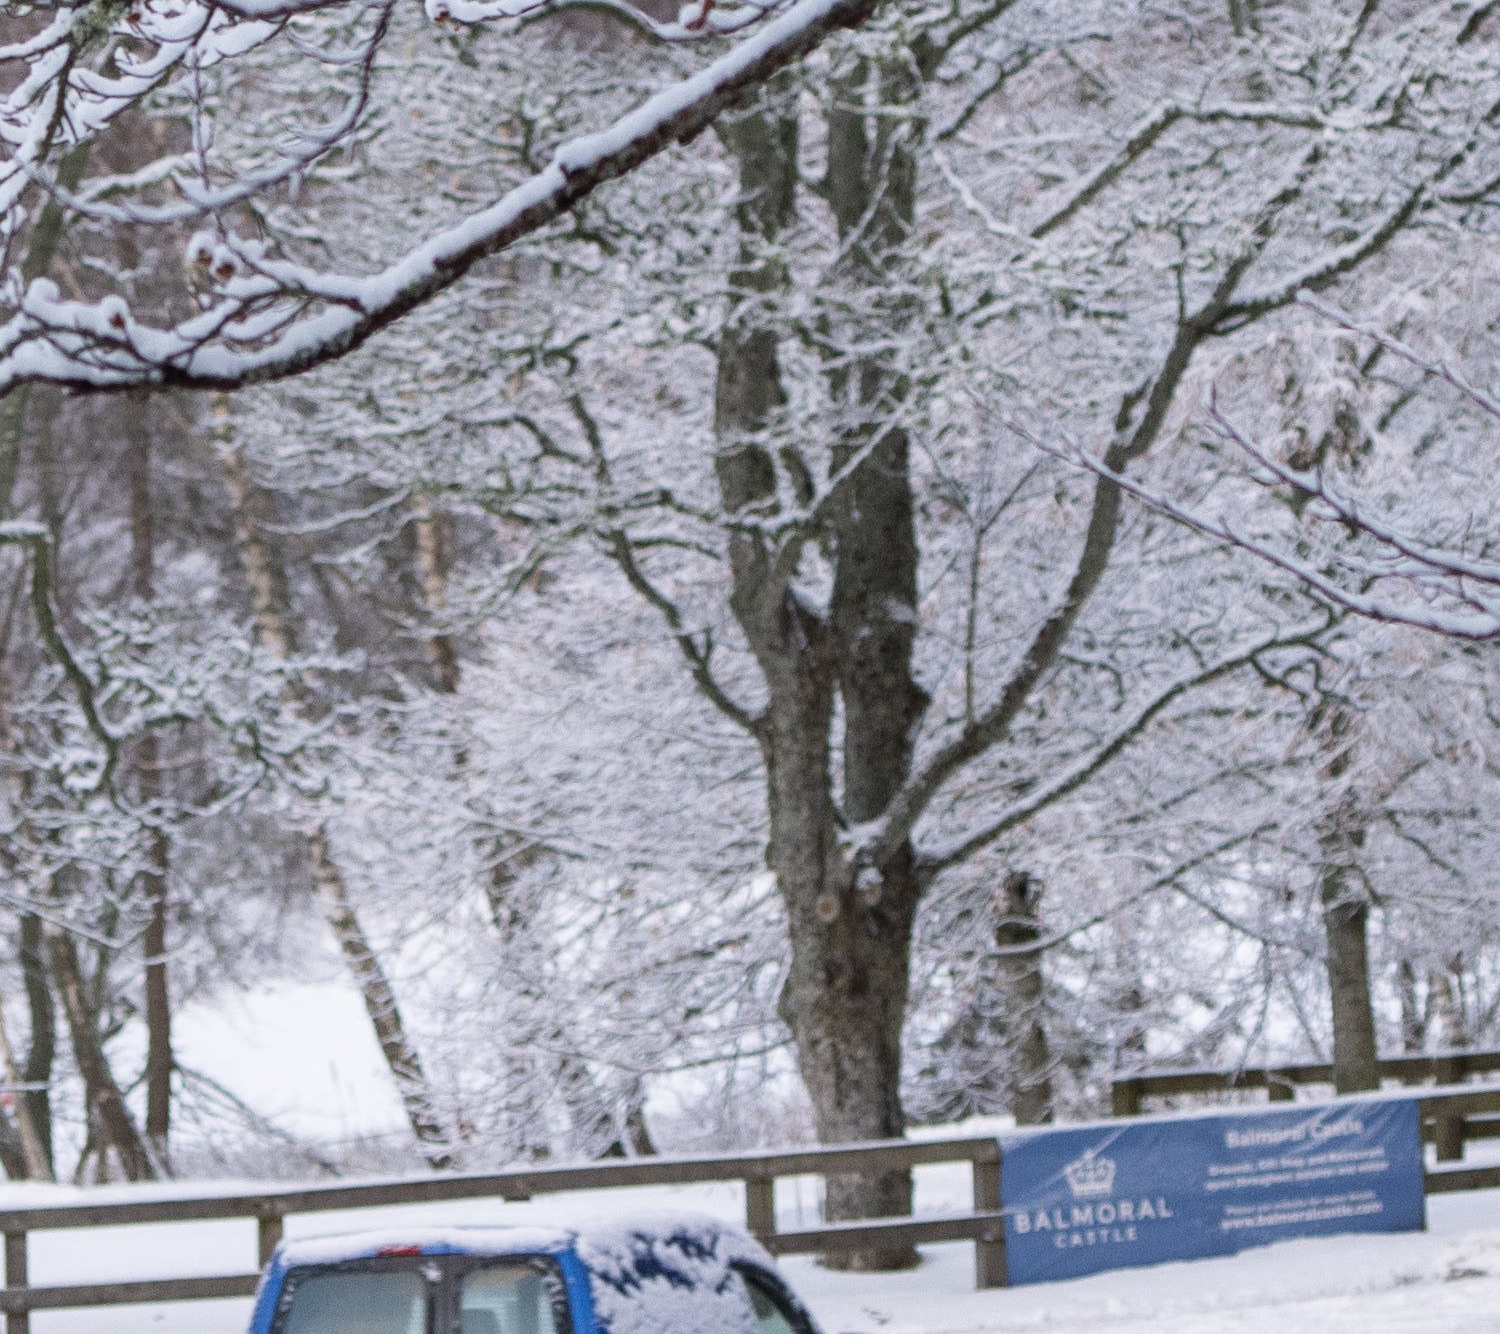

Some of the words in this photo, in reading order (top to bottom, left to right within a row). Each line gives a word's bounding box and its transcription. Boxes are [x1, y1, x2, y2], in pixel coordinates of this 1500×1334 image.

[1226, 1128, 1306, 1149] Balmoral
[1013, 1195, 1175, 1235] BALMORAL
[1053, 1224, 1138, 1249] CASTLE
